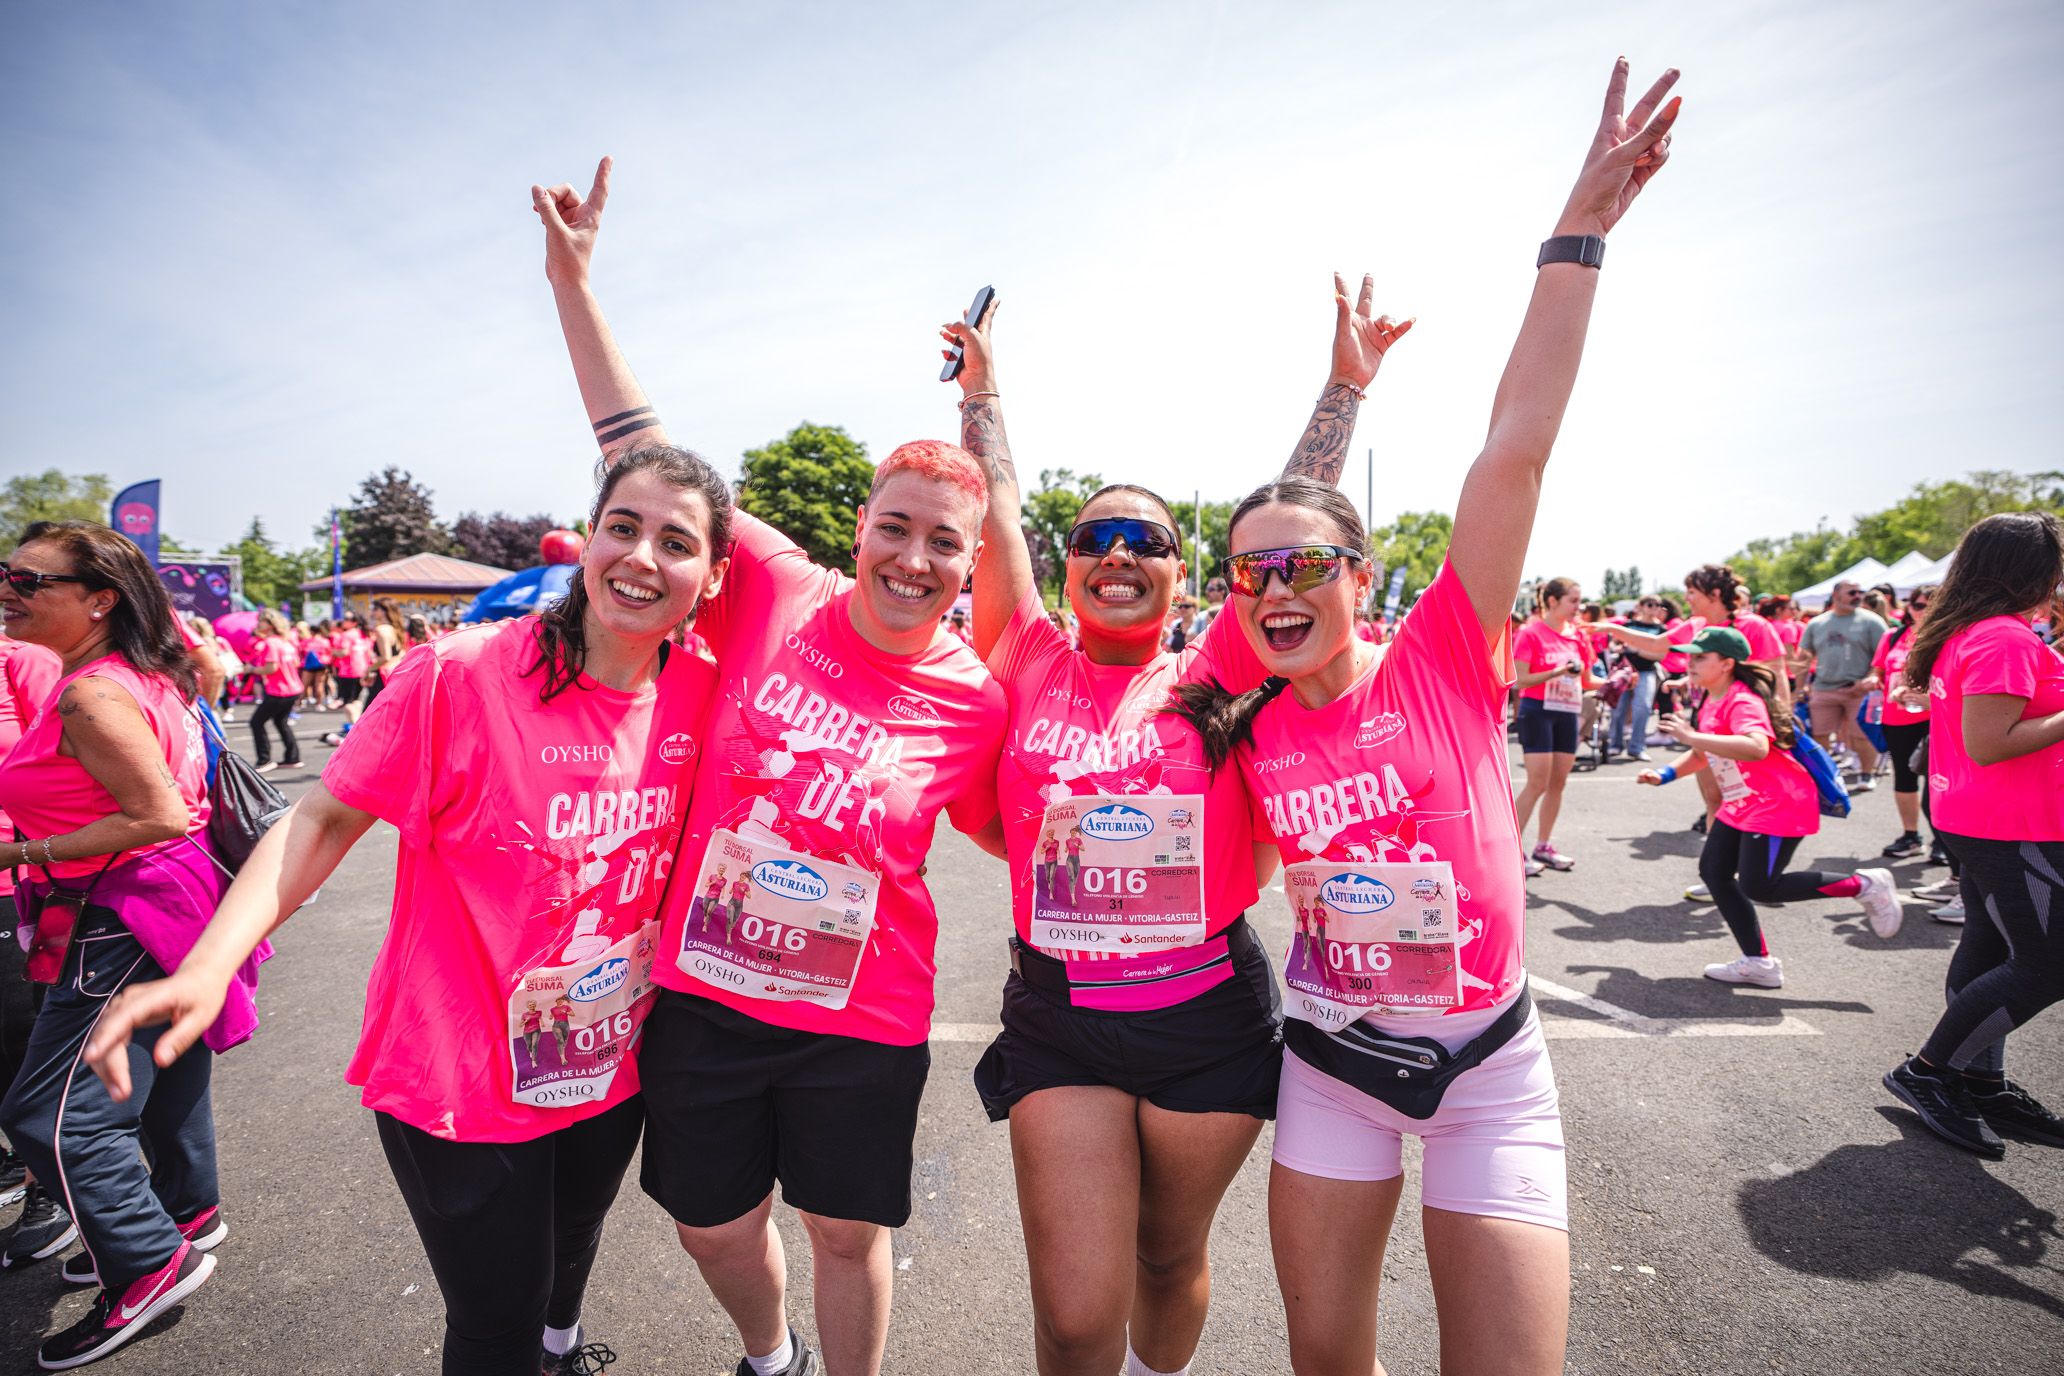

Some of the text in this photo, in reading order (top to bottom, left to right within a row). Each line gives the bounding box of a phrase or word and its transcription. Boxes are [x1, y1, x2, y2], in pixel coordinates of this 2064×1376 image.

[785, 634, 843, 678] OYSHO
[754, 671, 905, 766] CARRERA
[541, 745, 613, 763] OYSHO
[1023, 718, 1165, 774] CARRERA
[545, 784, 677, 840] CARRERA
[1046, 811, 1077, 823] SUMA
[1085, 818, 1148, 832] ASTURIANA
[722, 845, 751, 864] SUMA
[756, 866, 821, 897] ASTURIANA
[1083, 867, 1148, 894] 016
[1151, 868, 1197, 877] CORREDORA
[1292, 877, 1318, 887] SUMA
[1326, 886, 1388, 904] ASTURIANA
[1109, 899, 1123, 910] 31
[1037, 909, 1198, 923] CARRERA DE LA MUJER VITORIA-GASTEIZ
[741, 917, 808, 952] 016
[812, 933, 859, 948] CORREDORA
[1049, 927, 1100, 943] OYSHO
[1134, 933, 1186, 944] Santander
[758, 949, 781, 963] 694
[1328, 941, 1392, 972] 016
[1395, 945, 1452, 954] CORREDORA
[687, 940, 847, 987] CARRERA DE LA MUJER VITORIA-GASTEIZ
[695, 958, 745, 986] OYSHO
[1156, 963, 1174, 975] Mujer
[526, 982, 564, 992] SUMA
[778, 985, 829, 999] Santander
[1288, 978, 1324, 995] CARRERA
[1326, 987, 1334, 997] DE
[1374, 992, 1455, 1005] VITORIA-GASTEIZ
[1348, 978, 1372, 990] 300
[1302, 999, 1347, 1025] OYSHO
[574, 1010, 632, 1051] 016
[597, 1043, 618, 1061] 696
[519, 1060, 614, 1089] CARRERA DE LA MUJER
[534, 1083, 594, 1104] OYSHO
